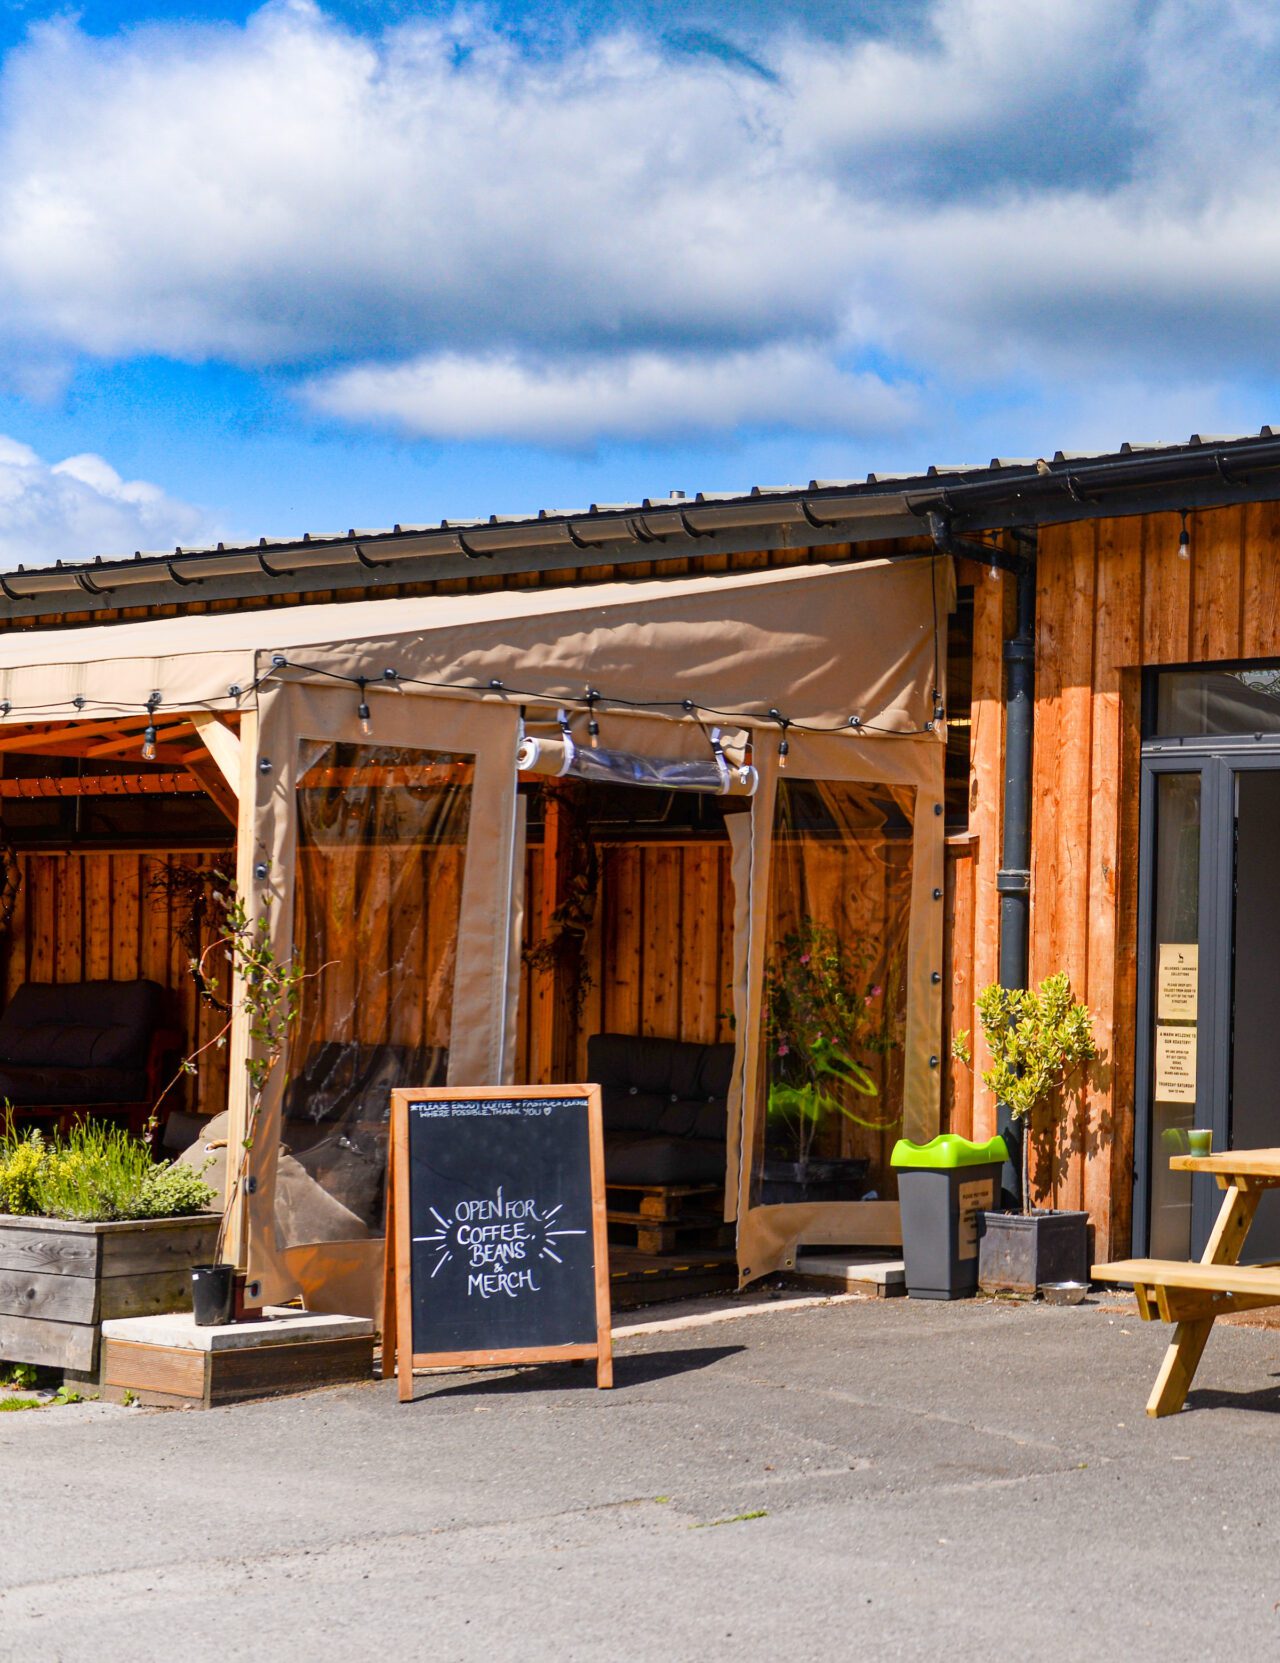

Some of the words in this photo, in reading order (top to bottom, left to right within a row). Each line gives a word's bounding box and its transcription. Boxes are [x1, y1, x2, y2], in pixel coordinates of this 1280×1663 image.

[420, 1109, 450, 1118] WHERE
[492, 1107, 521, 1116] THANK
[523, 1107, 542, 1116] YOU
[454, 1187, 503, 1222] OPEN
[505, 1199, 543, 1222] FOR
[468, 1241, 526, 1267] BEANS
[493, 1262, 504, 1273] &
[467, 1269, 541, 1299] MERCH
